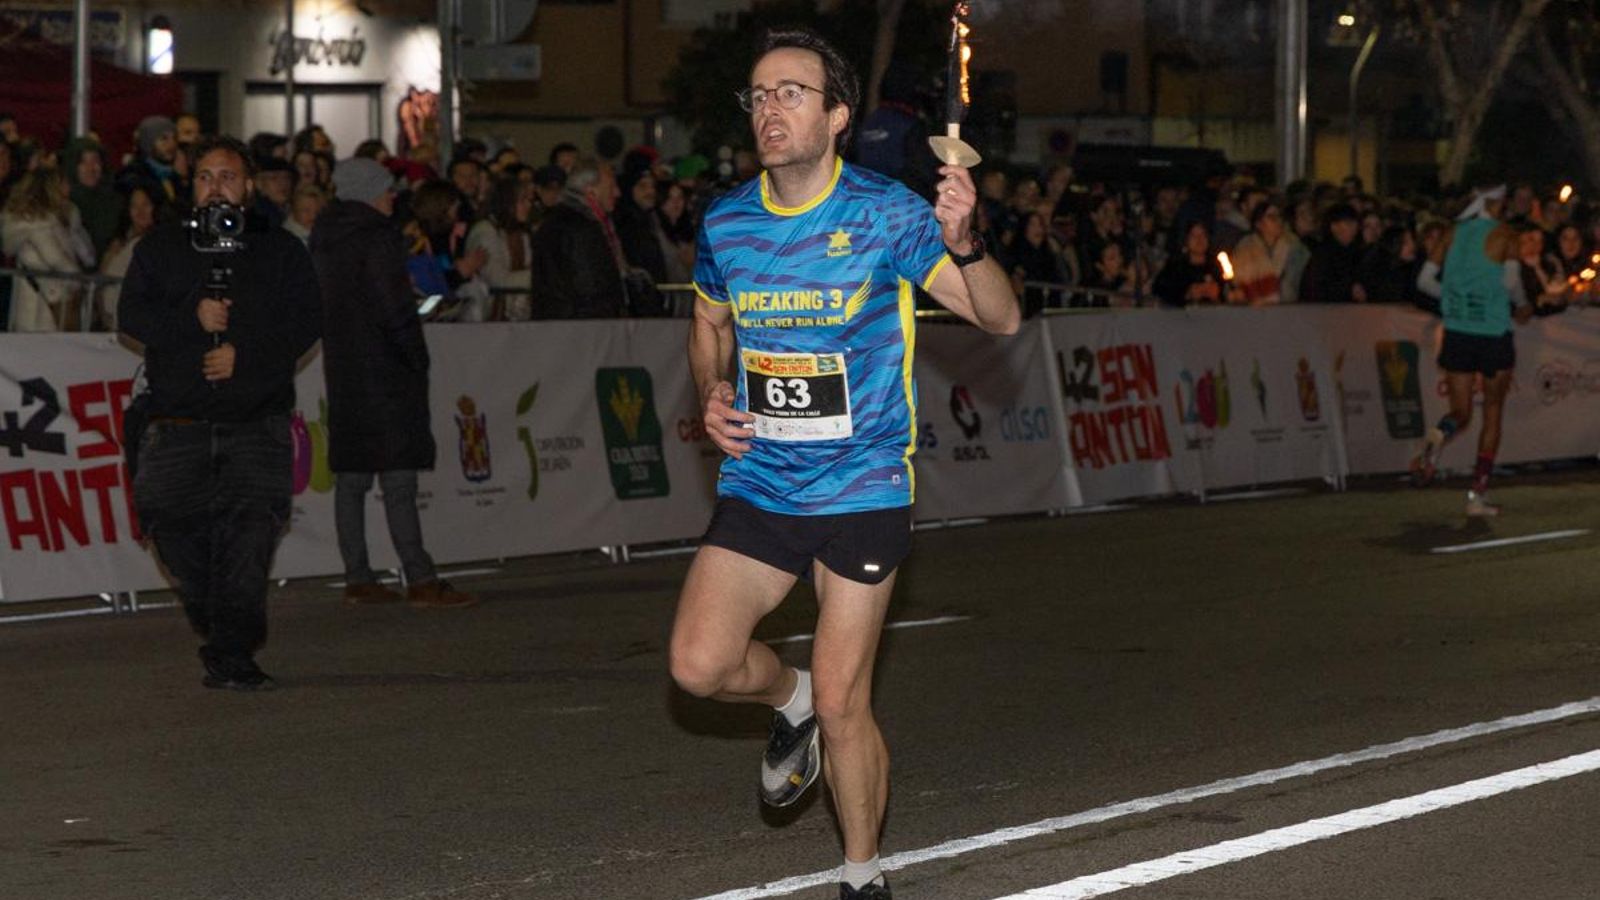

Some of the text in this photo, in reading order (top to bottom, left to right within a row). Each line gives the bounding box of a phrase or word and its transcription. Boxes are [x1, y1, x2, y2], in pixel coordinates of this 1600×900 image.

[738, 288, 842, 311] BREAKING 3
[765, 318, 793, 328] NEVER
[796, 317, 814, 327] RUN
[766, 378, 811, 408] 63
[1057, 344, 1157, 403] 42 SAN
[0, 377, 66, 457] 42
[1001, 402, 1049, 442] alsa
[1070, 405, 1172, 469] ANTON
[0, 466, 145, 552] ANT
